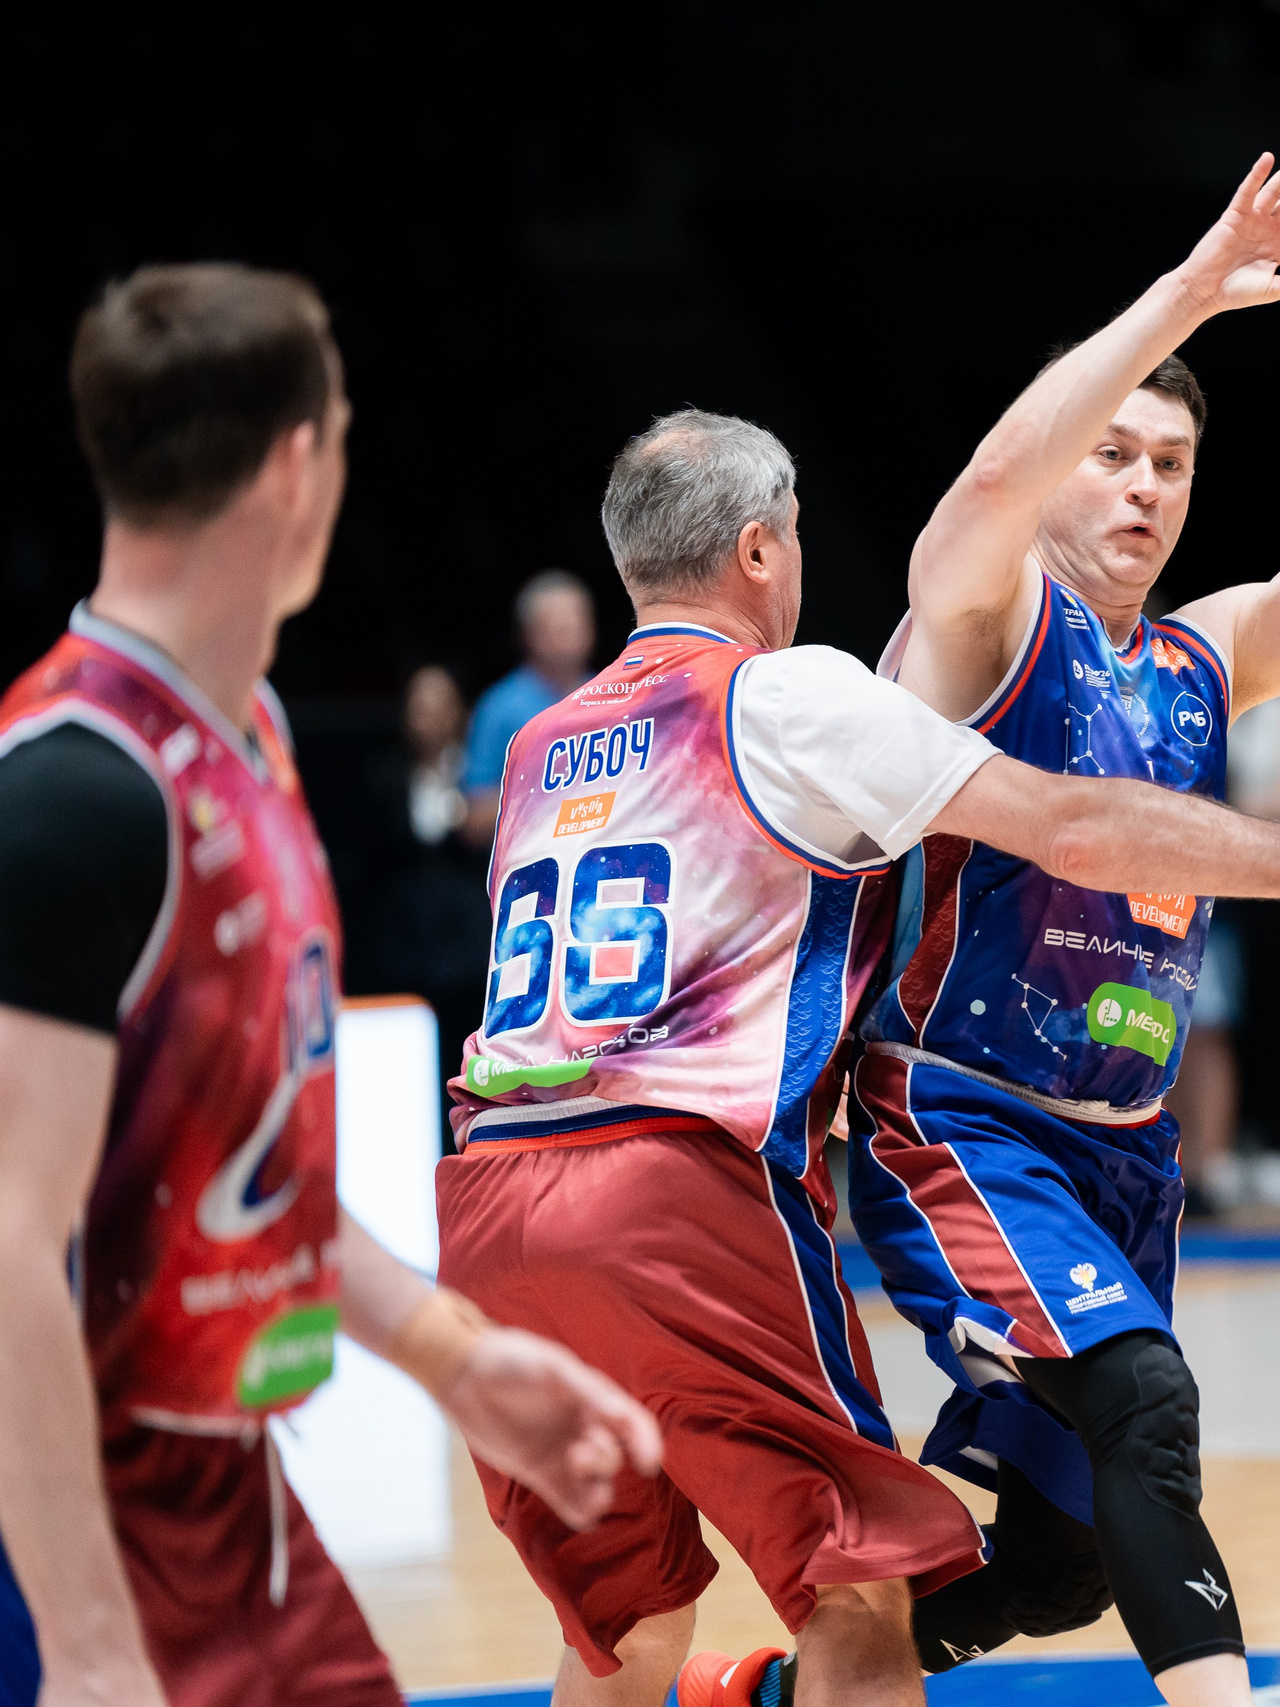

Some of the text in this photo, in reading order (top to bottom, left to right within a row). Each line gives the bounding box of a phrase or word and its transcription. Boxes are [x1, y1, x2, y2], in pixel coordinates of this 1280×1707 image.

[541, 717, 655, 794] СУБОЧ
[557, 816, 606, 835] DEVELOPMENT
[1065, 1281, 1123, 1306] ЦЕНТРАЛЬНЫЙ
